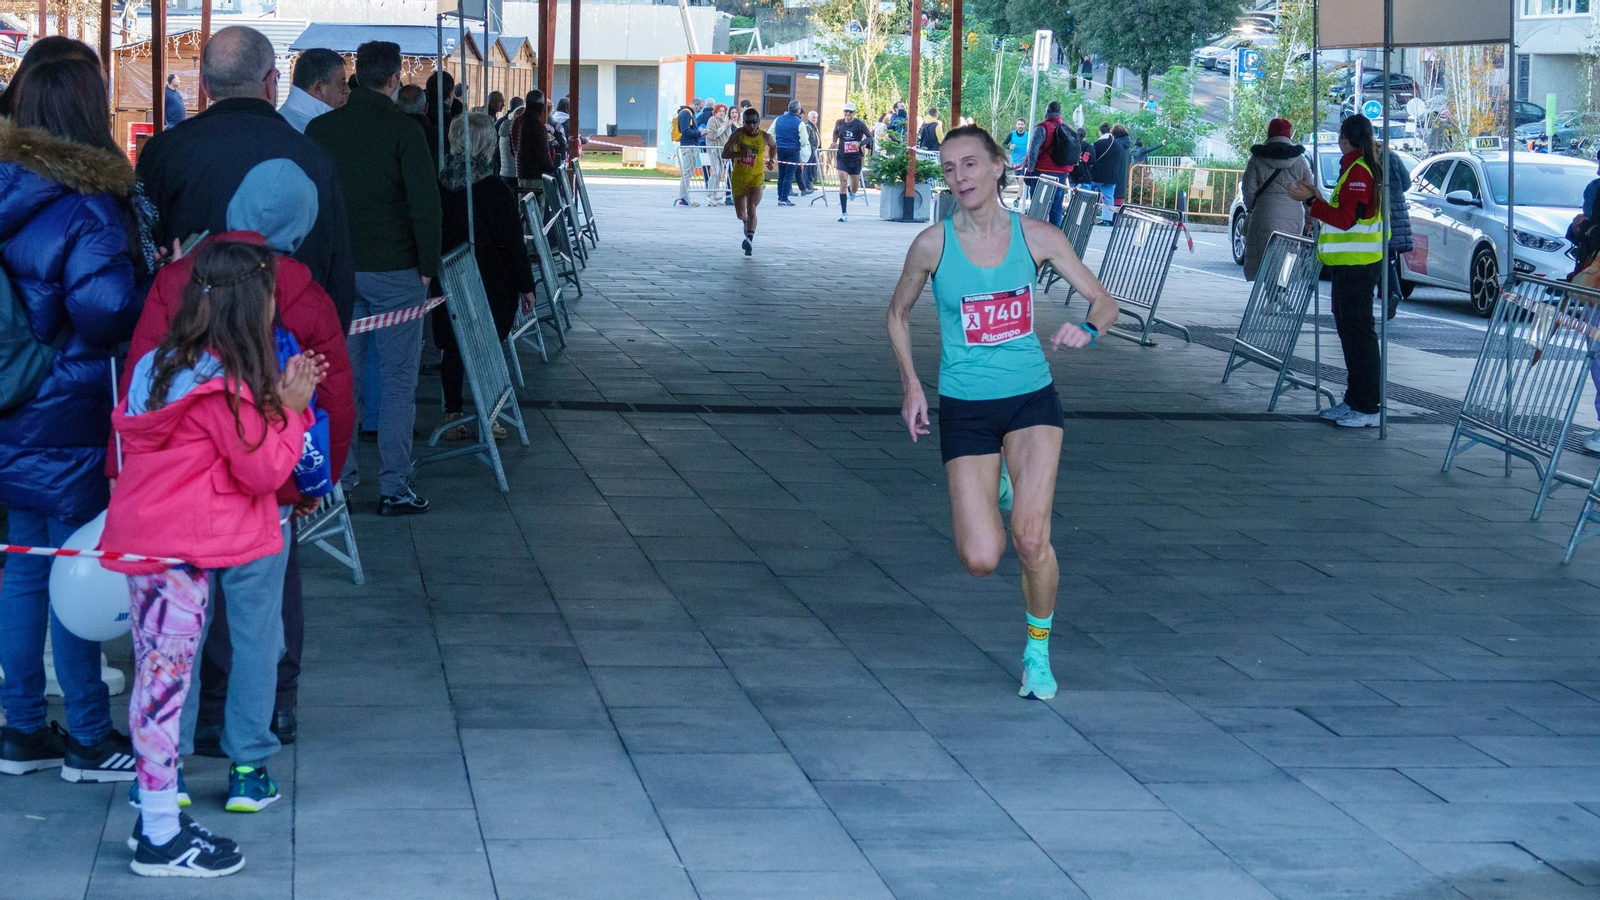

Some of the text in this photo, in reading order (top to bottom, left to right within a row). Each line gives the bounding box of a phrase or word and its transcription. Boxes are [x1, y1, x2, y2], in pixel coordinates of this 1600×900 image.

[1477, 138, 1494, 147] TAXI
[984, 301, 1022, 325] 740
[981, 328, 1021, 342] Alcampo
